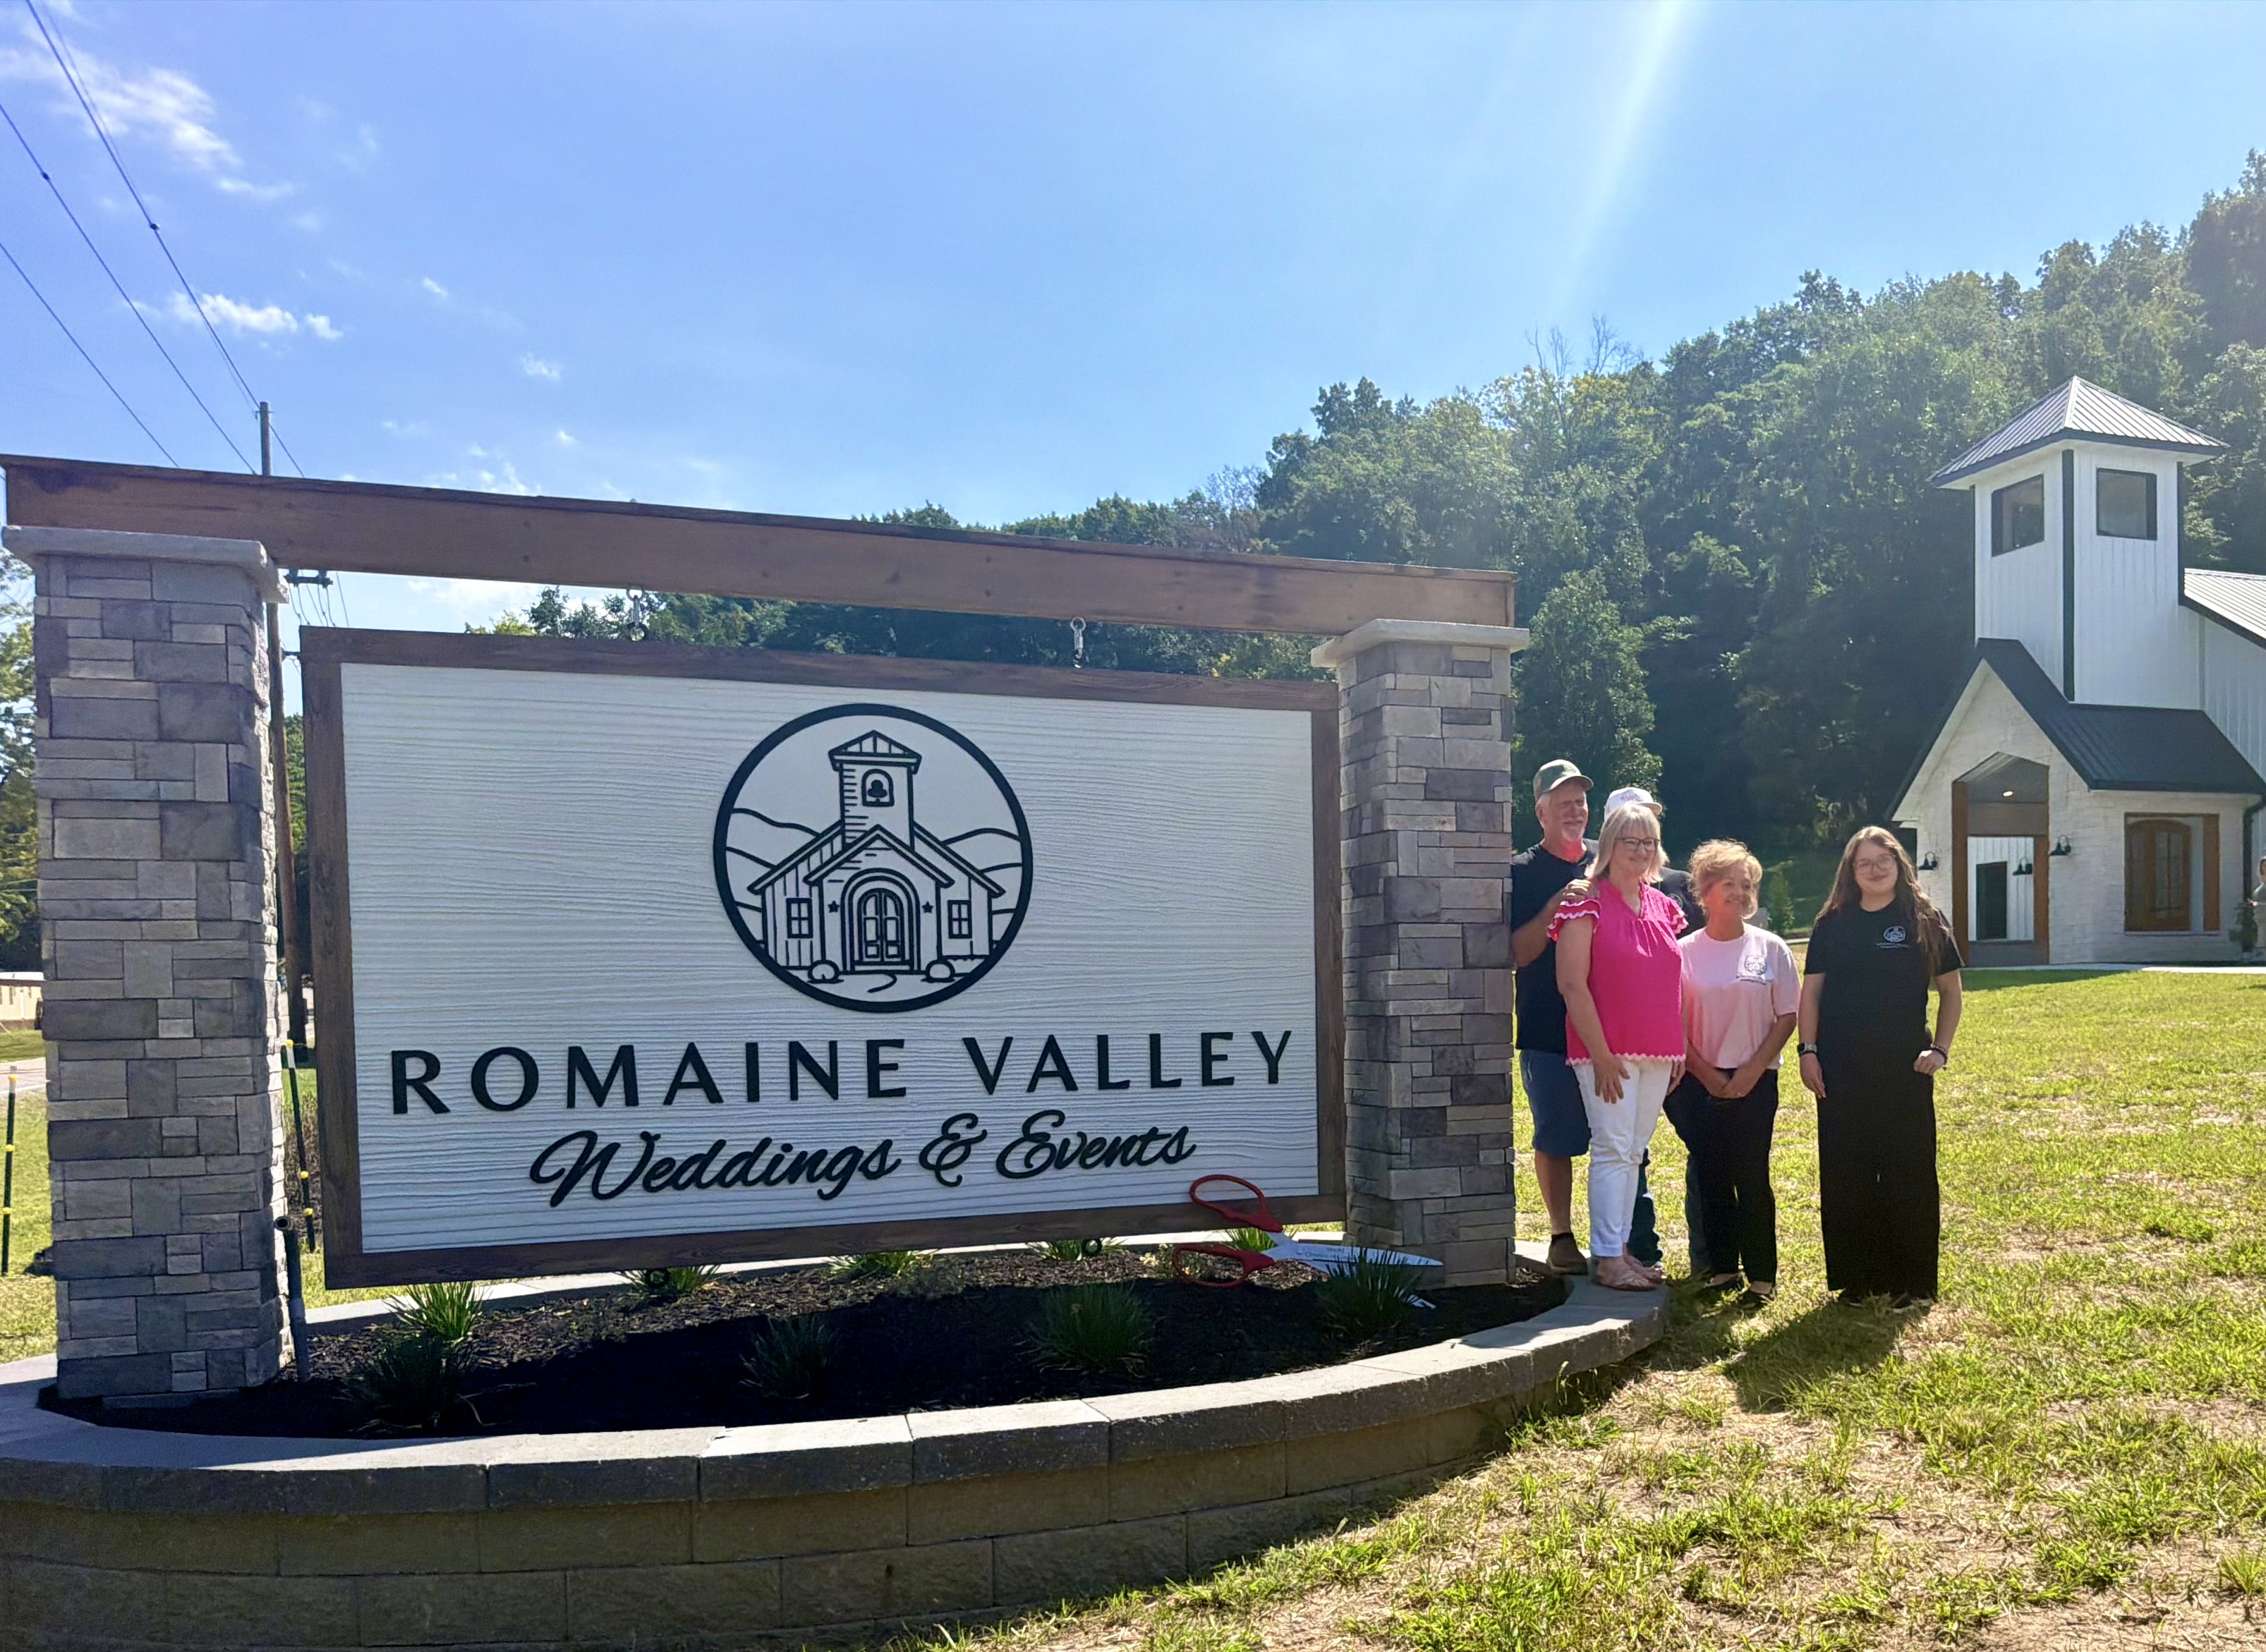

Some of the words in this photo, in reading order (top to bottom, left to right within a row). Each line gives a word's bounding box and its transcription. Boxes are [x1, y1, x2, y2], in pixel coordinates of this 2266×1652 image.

[391, 1038, 907, 1115] ROMAINE
[962, 1030, 1292, 1095] VALLEY
[528, 1129, 902, 1208] Weddings
[919, 1112, 988, 1188] &
[995, 1109, 1197, 1179] Events
